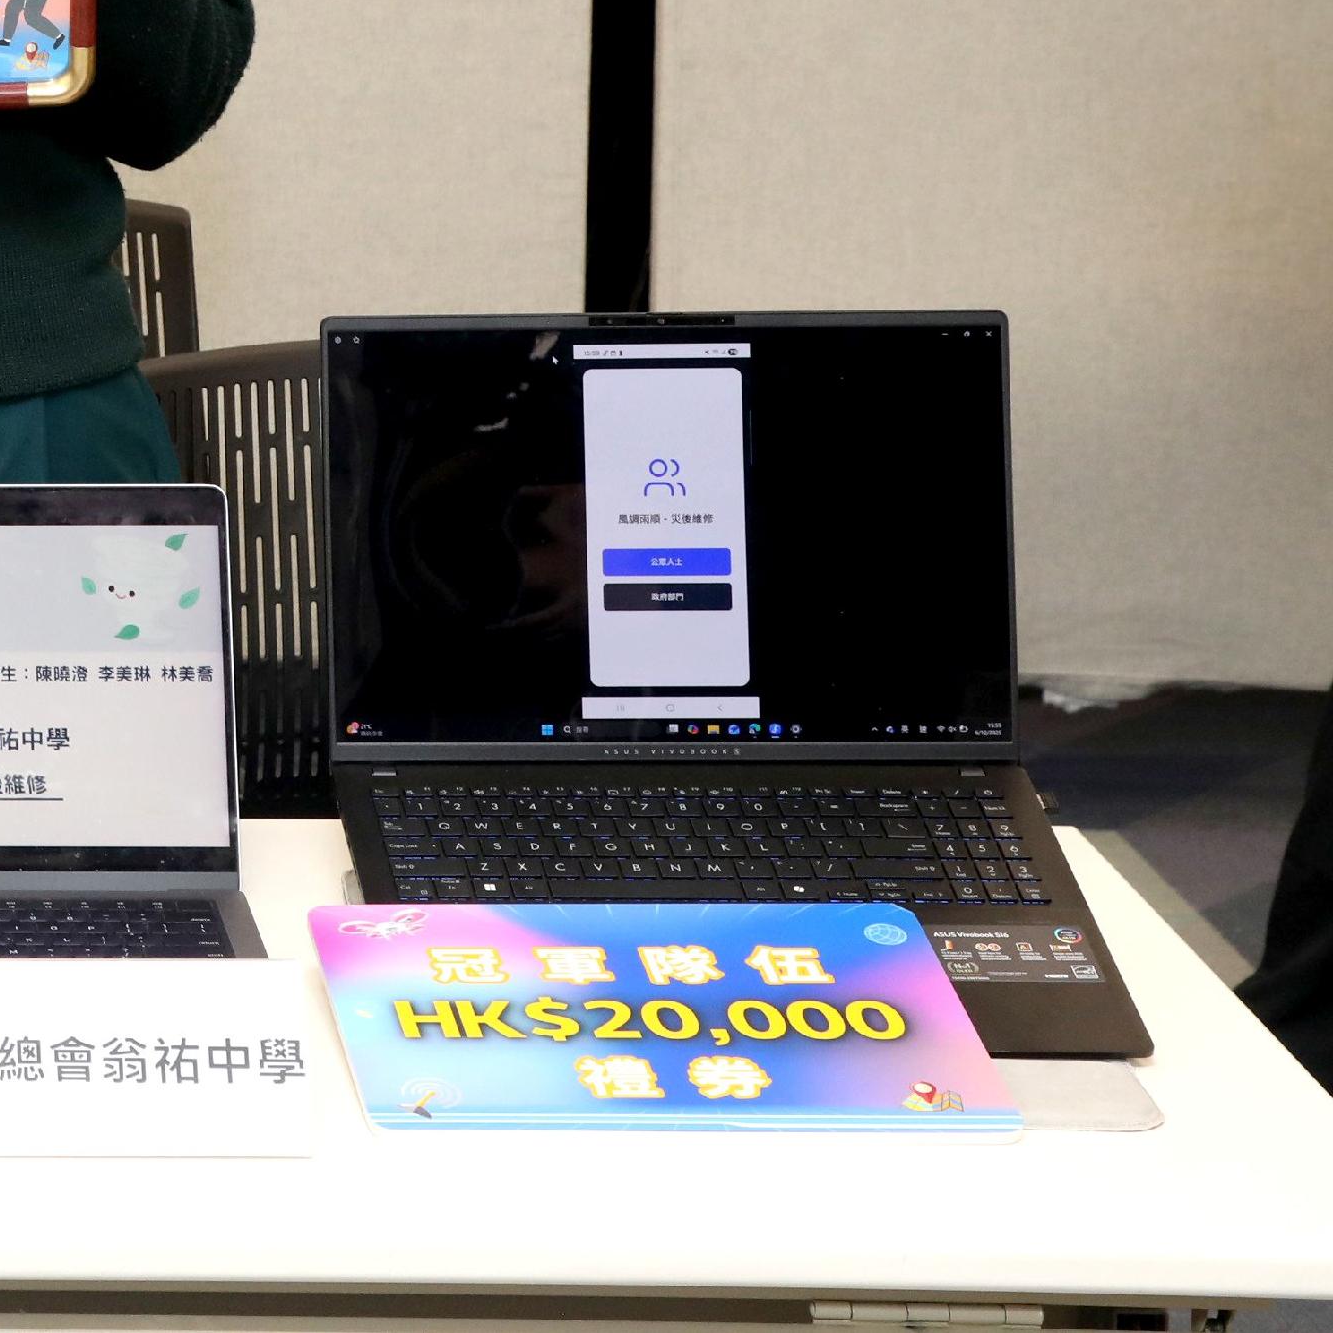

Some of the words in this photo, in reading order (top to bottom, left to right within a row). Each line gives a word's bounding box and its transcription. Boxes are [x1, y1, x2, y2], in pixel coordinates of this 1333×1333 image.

[98, 664, 151, 683] 李美琳
[161, 664, 214, 683] 林美喬
[418, 802, 423, 811] 1
[453, 802, 461, 811] 2
[491, 803, 499, 811] 3
[603, 803, 612, 811] 6
[640, 803, 649, 811] 7
[679, 803, 687, 811] 8
[716, 803, 725, 811] 9
[753, 803, 763, 811] 0
[474, 822, 488, 830] W
[516, 822, 523, 830] E
[552, 822, 562, 830] R
[665, 823, 676, 831] U
[741, 823, 753, 831] O
[493, 842, 502, 850] S
[530, 842, 540, 851] D
[569, 843, 575, 851] F
[604, 843, 618, 851] G
[644, 843, 655, 851] H
[481, 862, 489, 871] Z
[517, 862, 527, 871] X
[554, 862, 566, 872] C
[593, 863, 603, 871] V
[632, 863, 641, 872] B
[670, 864, 682, 872] N
[707, 864, 722, 872] M
[427, 945, 835, 986] 冠軍隊伍
[393, 996, 907, 1046] HK$20,000
[573, 1055, 771, 1100] 禮券
